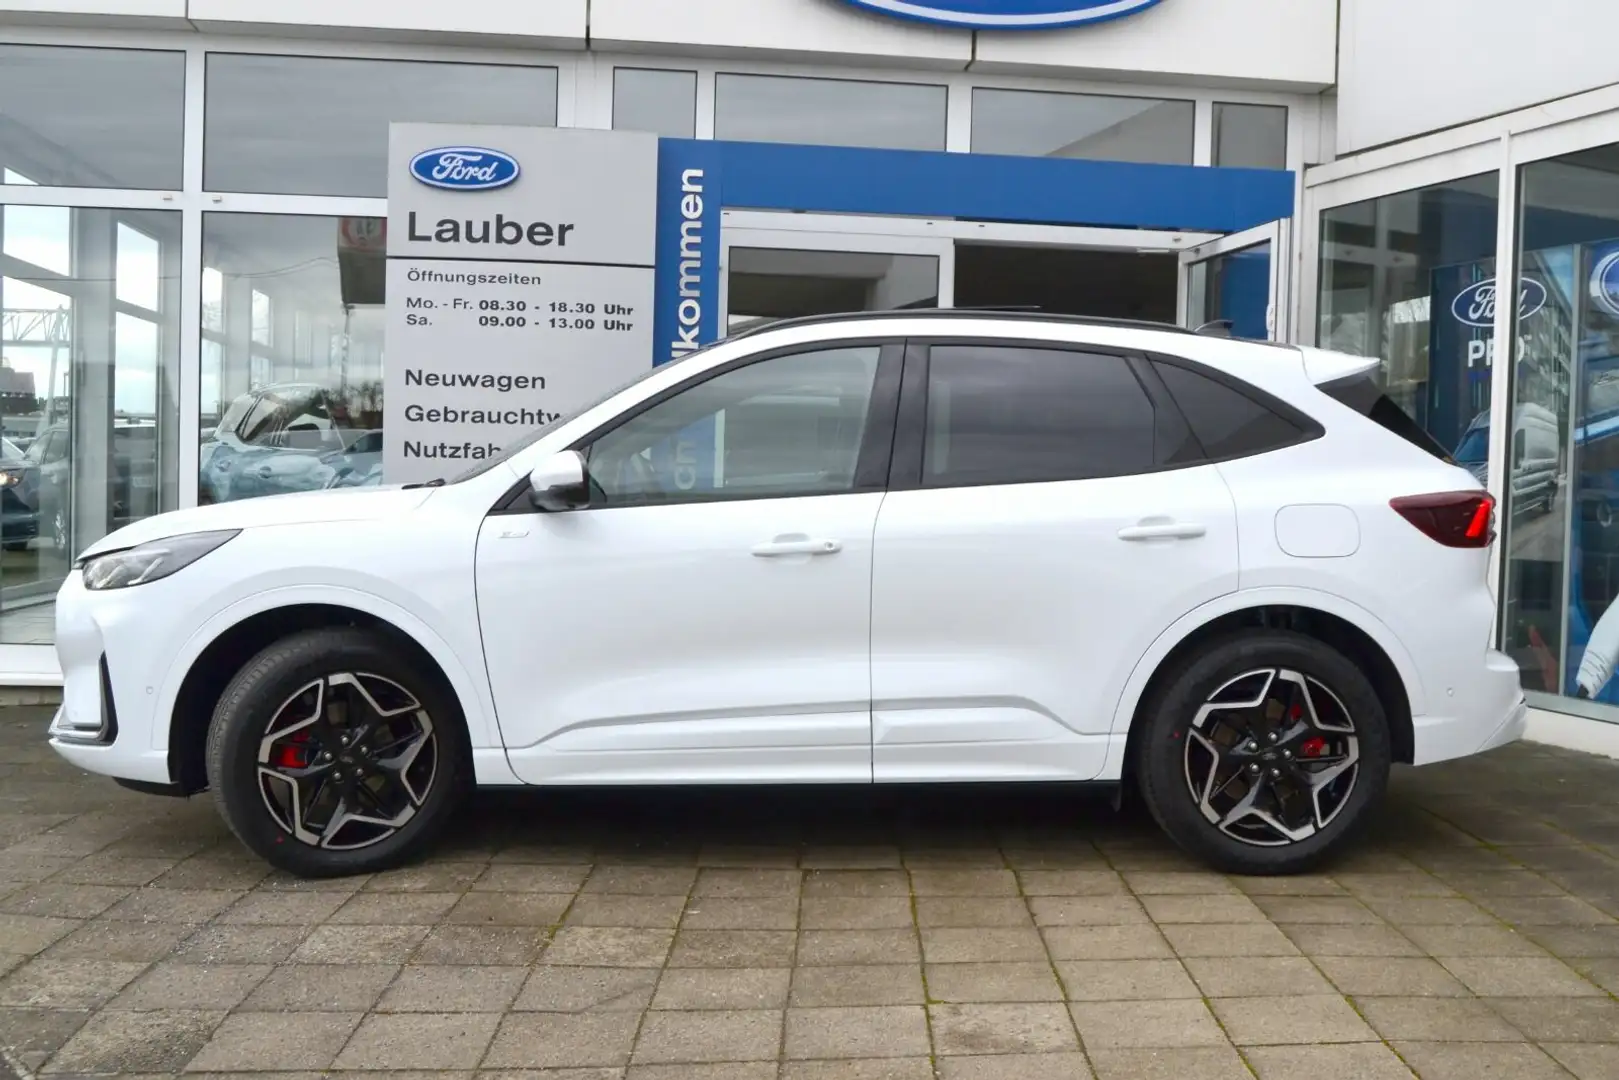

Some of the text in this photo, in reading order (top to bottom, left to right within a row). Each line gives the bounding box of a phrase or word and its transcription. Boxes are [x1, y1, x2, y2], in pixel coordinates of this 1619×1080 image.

[432, 152, 499, 182] Ford
[408, 211, 575, 247] Lauber
[407, 267, 542, 287] Öffnungszeiten
[406, 297, 438, 309] Mo.
[453, 298, 473, 311] Fr.
[478, 299, 527, 312] 08.30
[548, 301, 596, 314] 18.30
[603, 303, 634, 316] Uhr
[406, 313, 433, 326] Sa.
[478, 315, 527, 328] 09.00
[548, 317, 596, 330] 13.00
[603, 319, 634, 332] Uhr
[405, 368, 546, 393] Neuwagen
